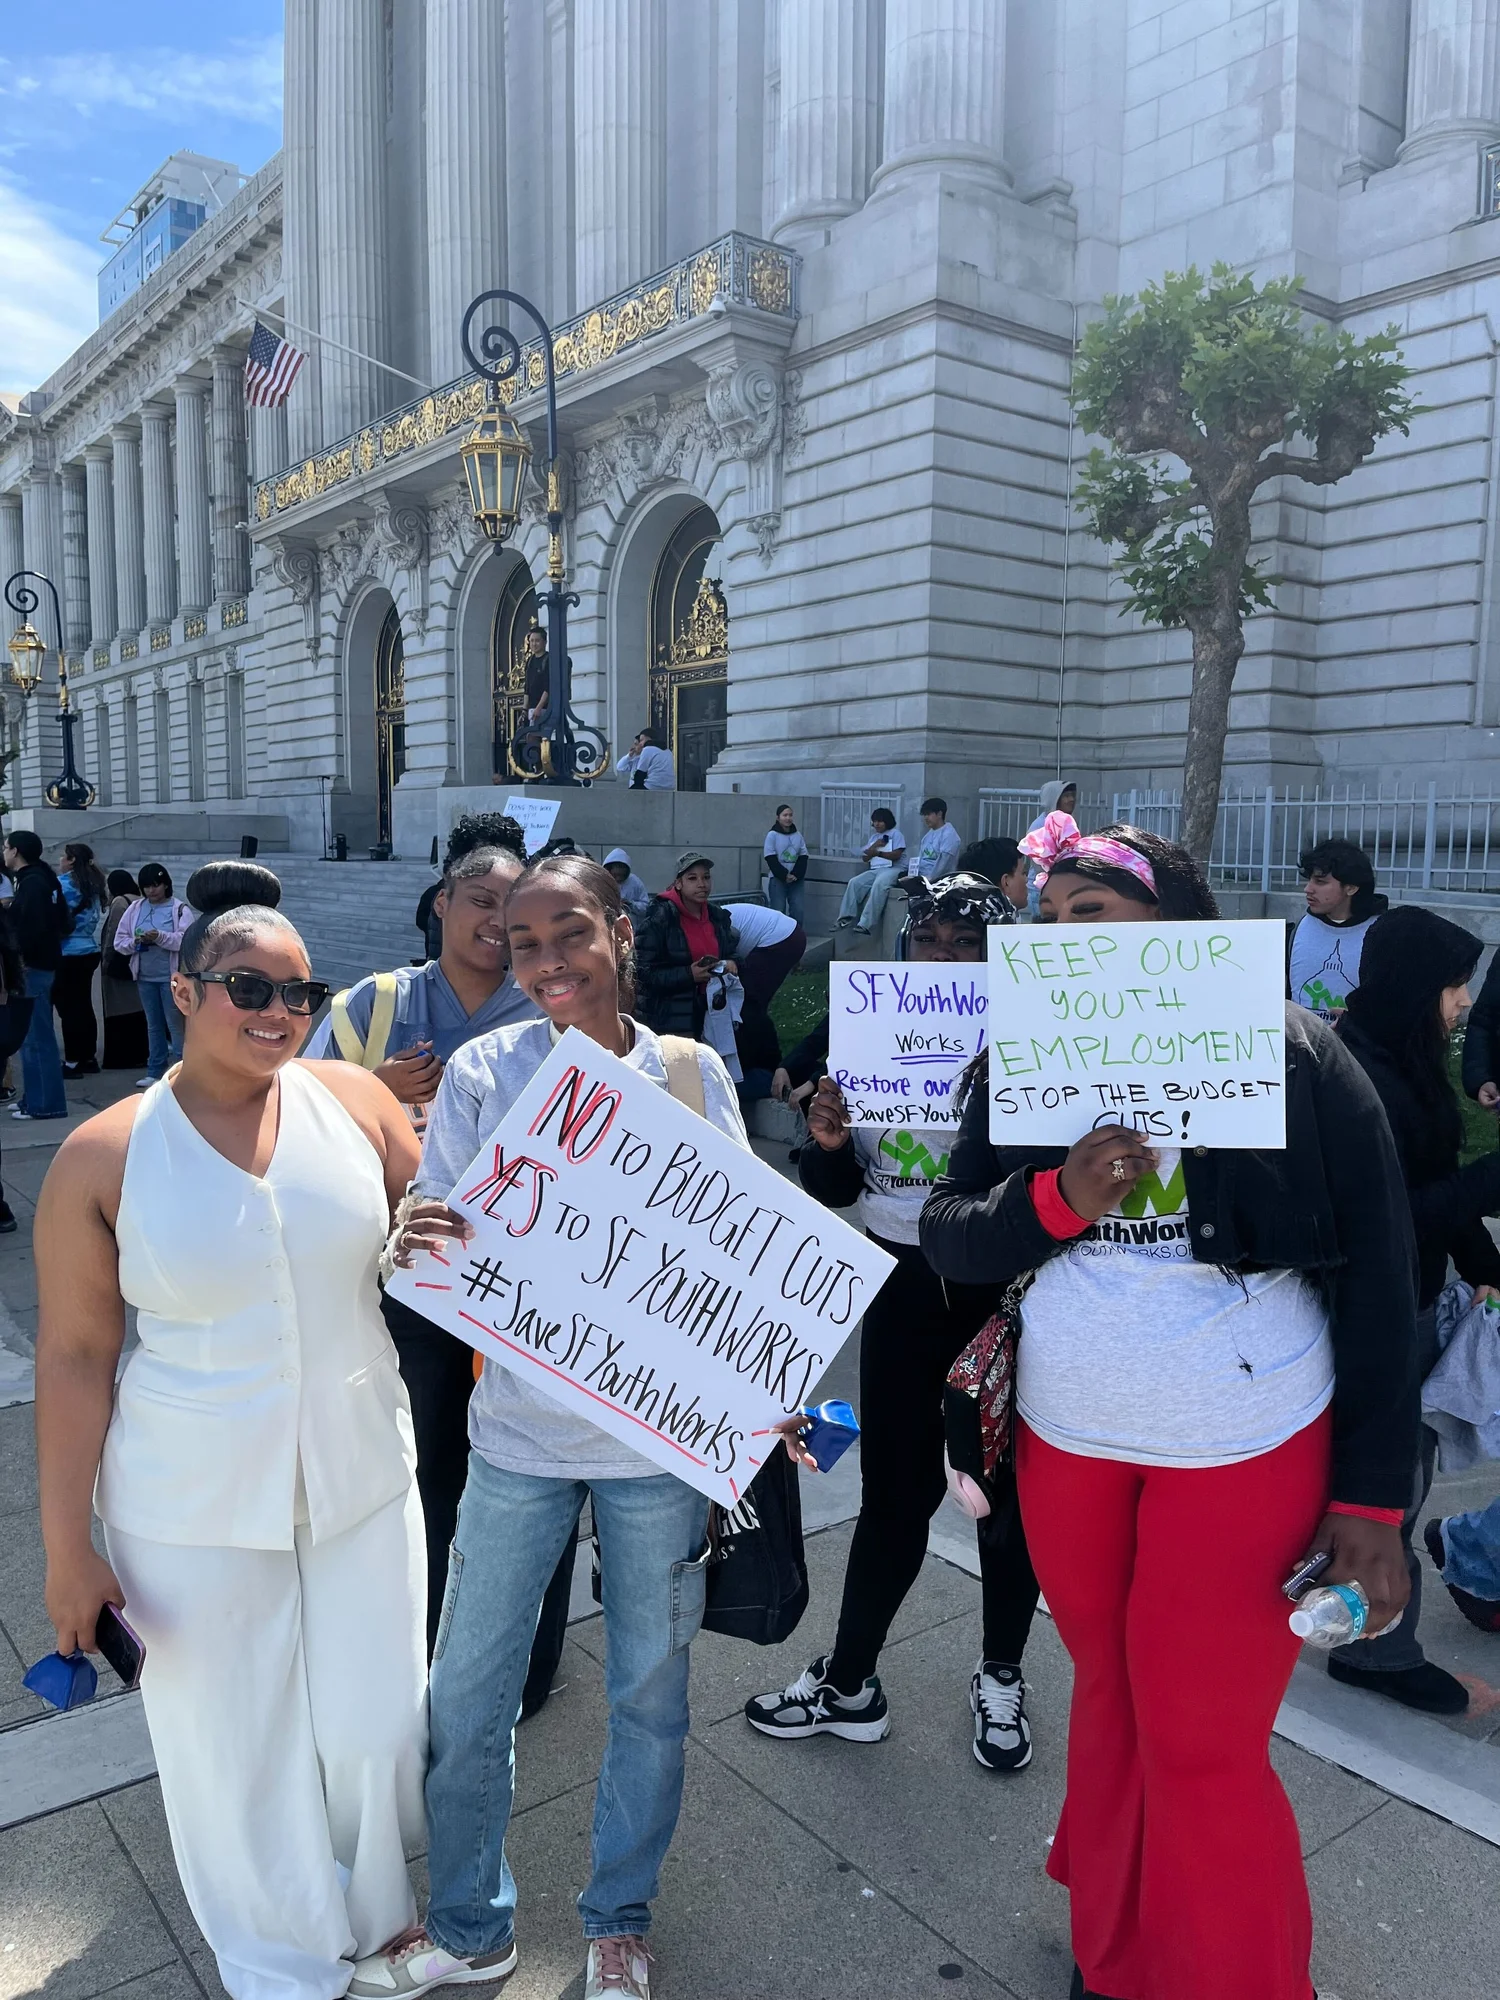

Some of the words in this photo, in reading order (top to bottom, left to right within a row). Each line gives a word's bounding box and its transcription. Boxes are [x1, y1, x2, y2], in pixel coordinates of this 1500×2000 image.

[1000, 935, 1117, 984] KEEP
[1140, 935, 1244, 975] OUR
[846, 970, 988, 1016] SFYouthWo
[1051, 985, 1187, 1020] YOUTH
[996, 1025, 1280, 1076] EMPLOYMENT
[836, 1069, 911, 1096] Restore
[924, 1079, 952, 1096] our
[994, 1086, 1080, 1114] STOP
[1090, 1083, 1150, 1108] THE
[1162, 1079, 1280, 1101] BUDGET
[460, 1143, 558, 1238] YES
[581, 1215, 647, 1289] SF
[527, 1065, 622, 1165] NO
[645, 1142, 796, 1277] BUDGET
[780, 1235, 864, 1325] CUTS
[460, 1257, 744, 1474] #SaveSFYouthWorks
